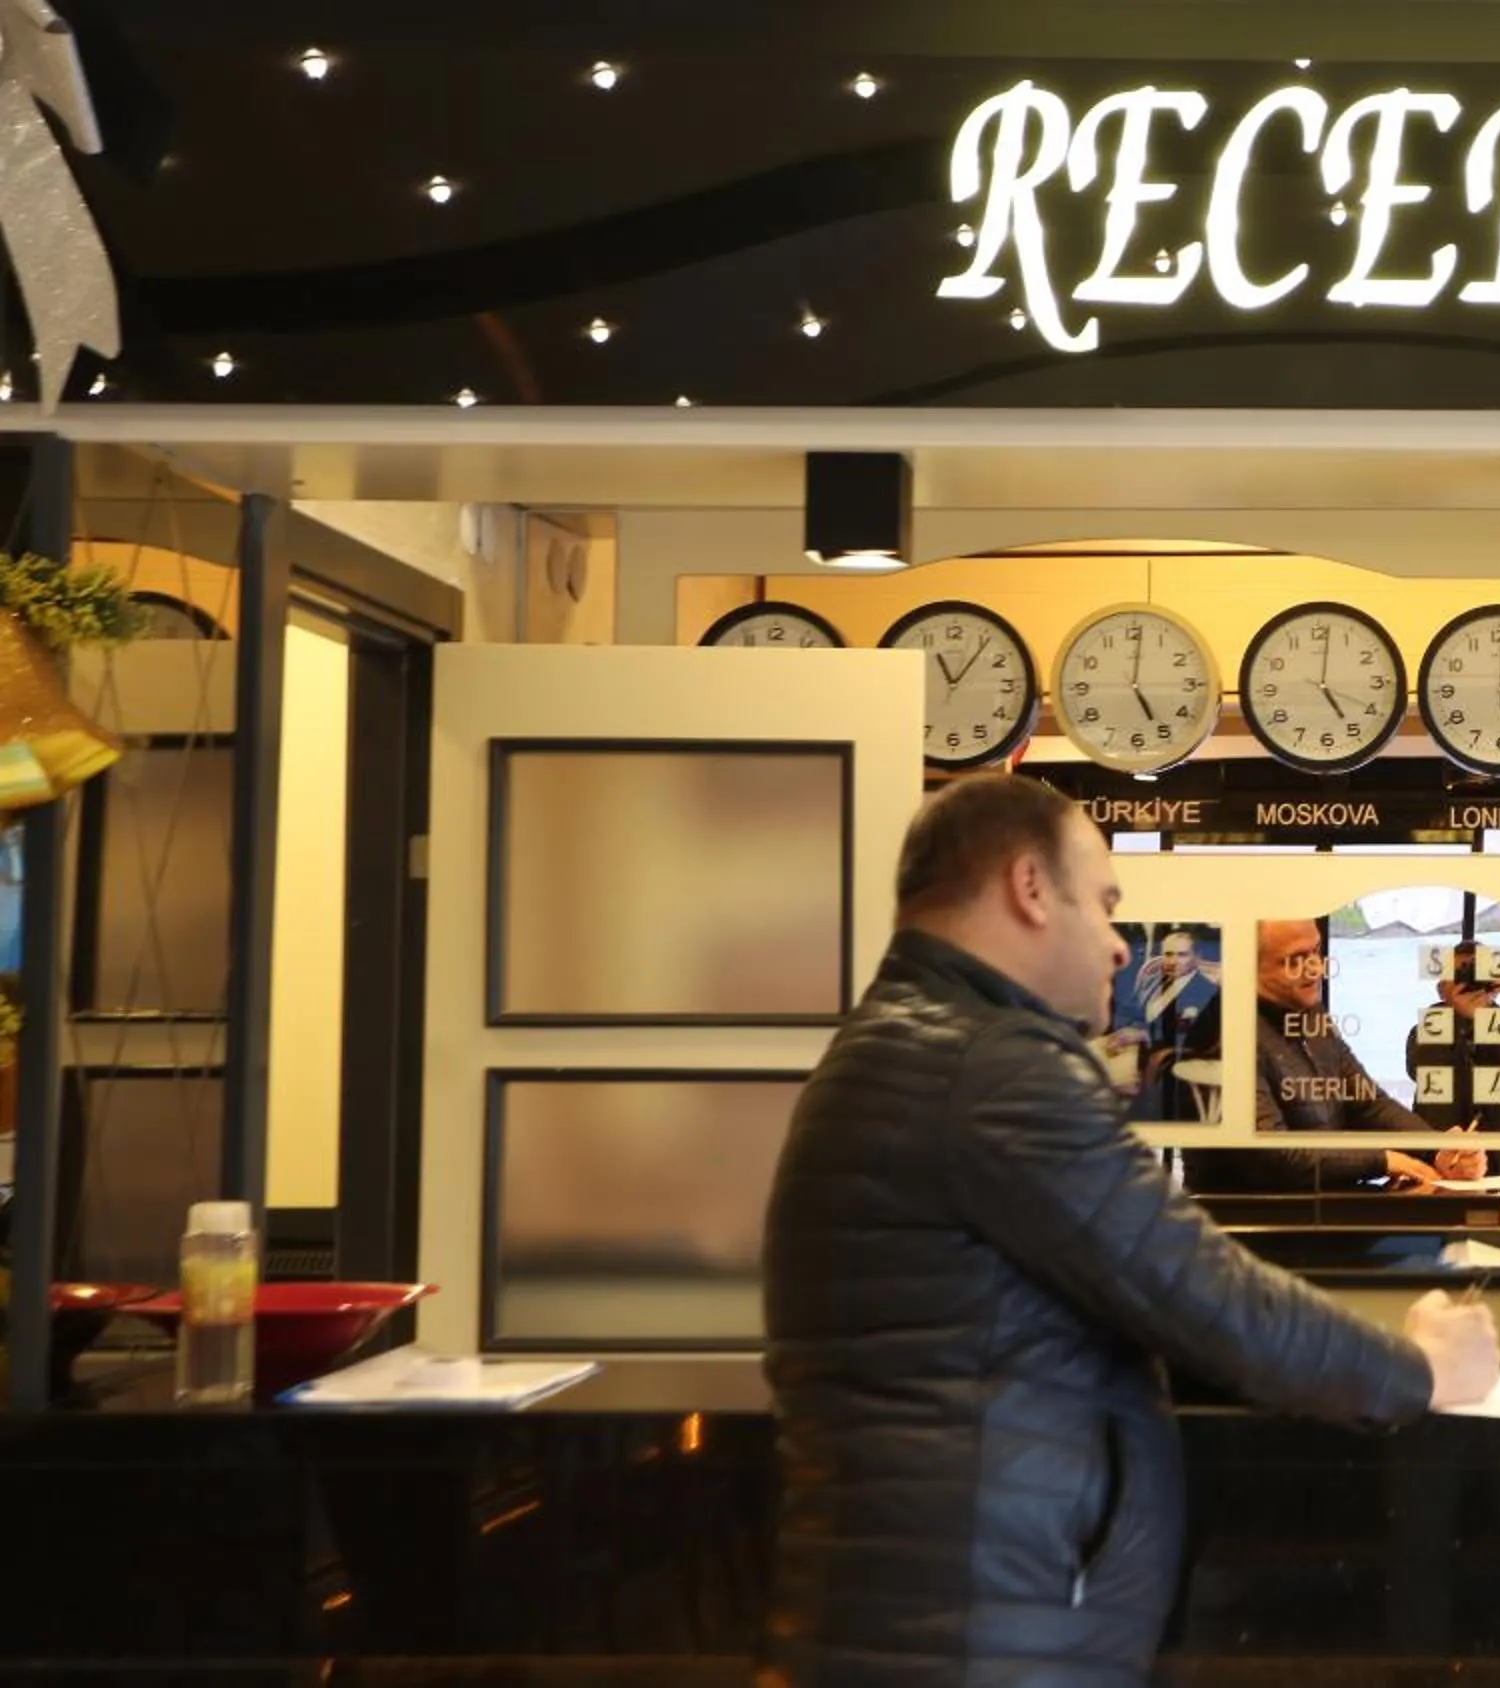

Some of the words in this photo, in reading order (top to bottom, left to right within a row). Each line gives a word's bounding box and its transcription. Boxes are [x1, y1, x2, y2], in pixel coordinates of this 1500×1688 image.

[768, 626, 784, 641] 12
[946, 625, 962, 640] 12
[1311, 626, 1328, 641] 12
[922, 633, 934, 647] 11
[1103, 636, 1113, 648] 11
[1289, 636, 1299, 650] 11
[1468, 638, 1478, 651] 11
[992, 655, 1005, 668] 2
[1083, 656, 1098, 669] 10
[1173, 653, 1187, 667] 2
[1270, 657, 1285, 671] 10
[1360, 651, 1373, 665] 2
[1448, 659, 1463, 672] 10
[1000, 679, 1014, 693] 3
[1075, 682, 1089, 695] 9
[1183, 678, 1197, 692] 3
[1263, 683, 1277, 697] 9
[1370, 676, 1384, 690] 3
[1440, 685, 1455, 699] 9
[992, 706, 1005, 719] 4
[1085, 708, 1099, 721] 8
[1175, 705, 1188, 718] 4
[1273, 709, 1288, 723] 8
[1364, 703, 1377, 716] 4
[1450, 710, 1465, 724] 8
[972, 725, 987, 739] 5
[1103, 727, 1116, 747] 7
[1157, 725, 1171, 739] 5
[1294, 727, 1306, 742] 7
[1347, 723, 1361, 738] 5
[1470, 729, 1482, 744] 7
[946, 733, 960, 747] 6
[1131, 733, 1145, 747] 6
[1320, 733, 1335, 747] 6
[1256, 803, 1380, 826] MOSKOVA
[1284, 955, 1340, 980] USD
[1284, 1012, 1361, 1038] EURO
[1423, 1011, 1443, 1036] €
[1280, 1072, 1378, 1102] STERLİN
[1423, 1070, 1444, 1095] £
